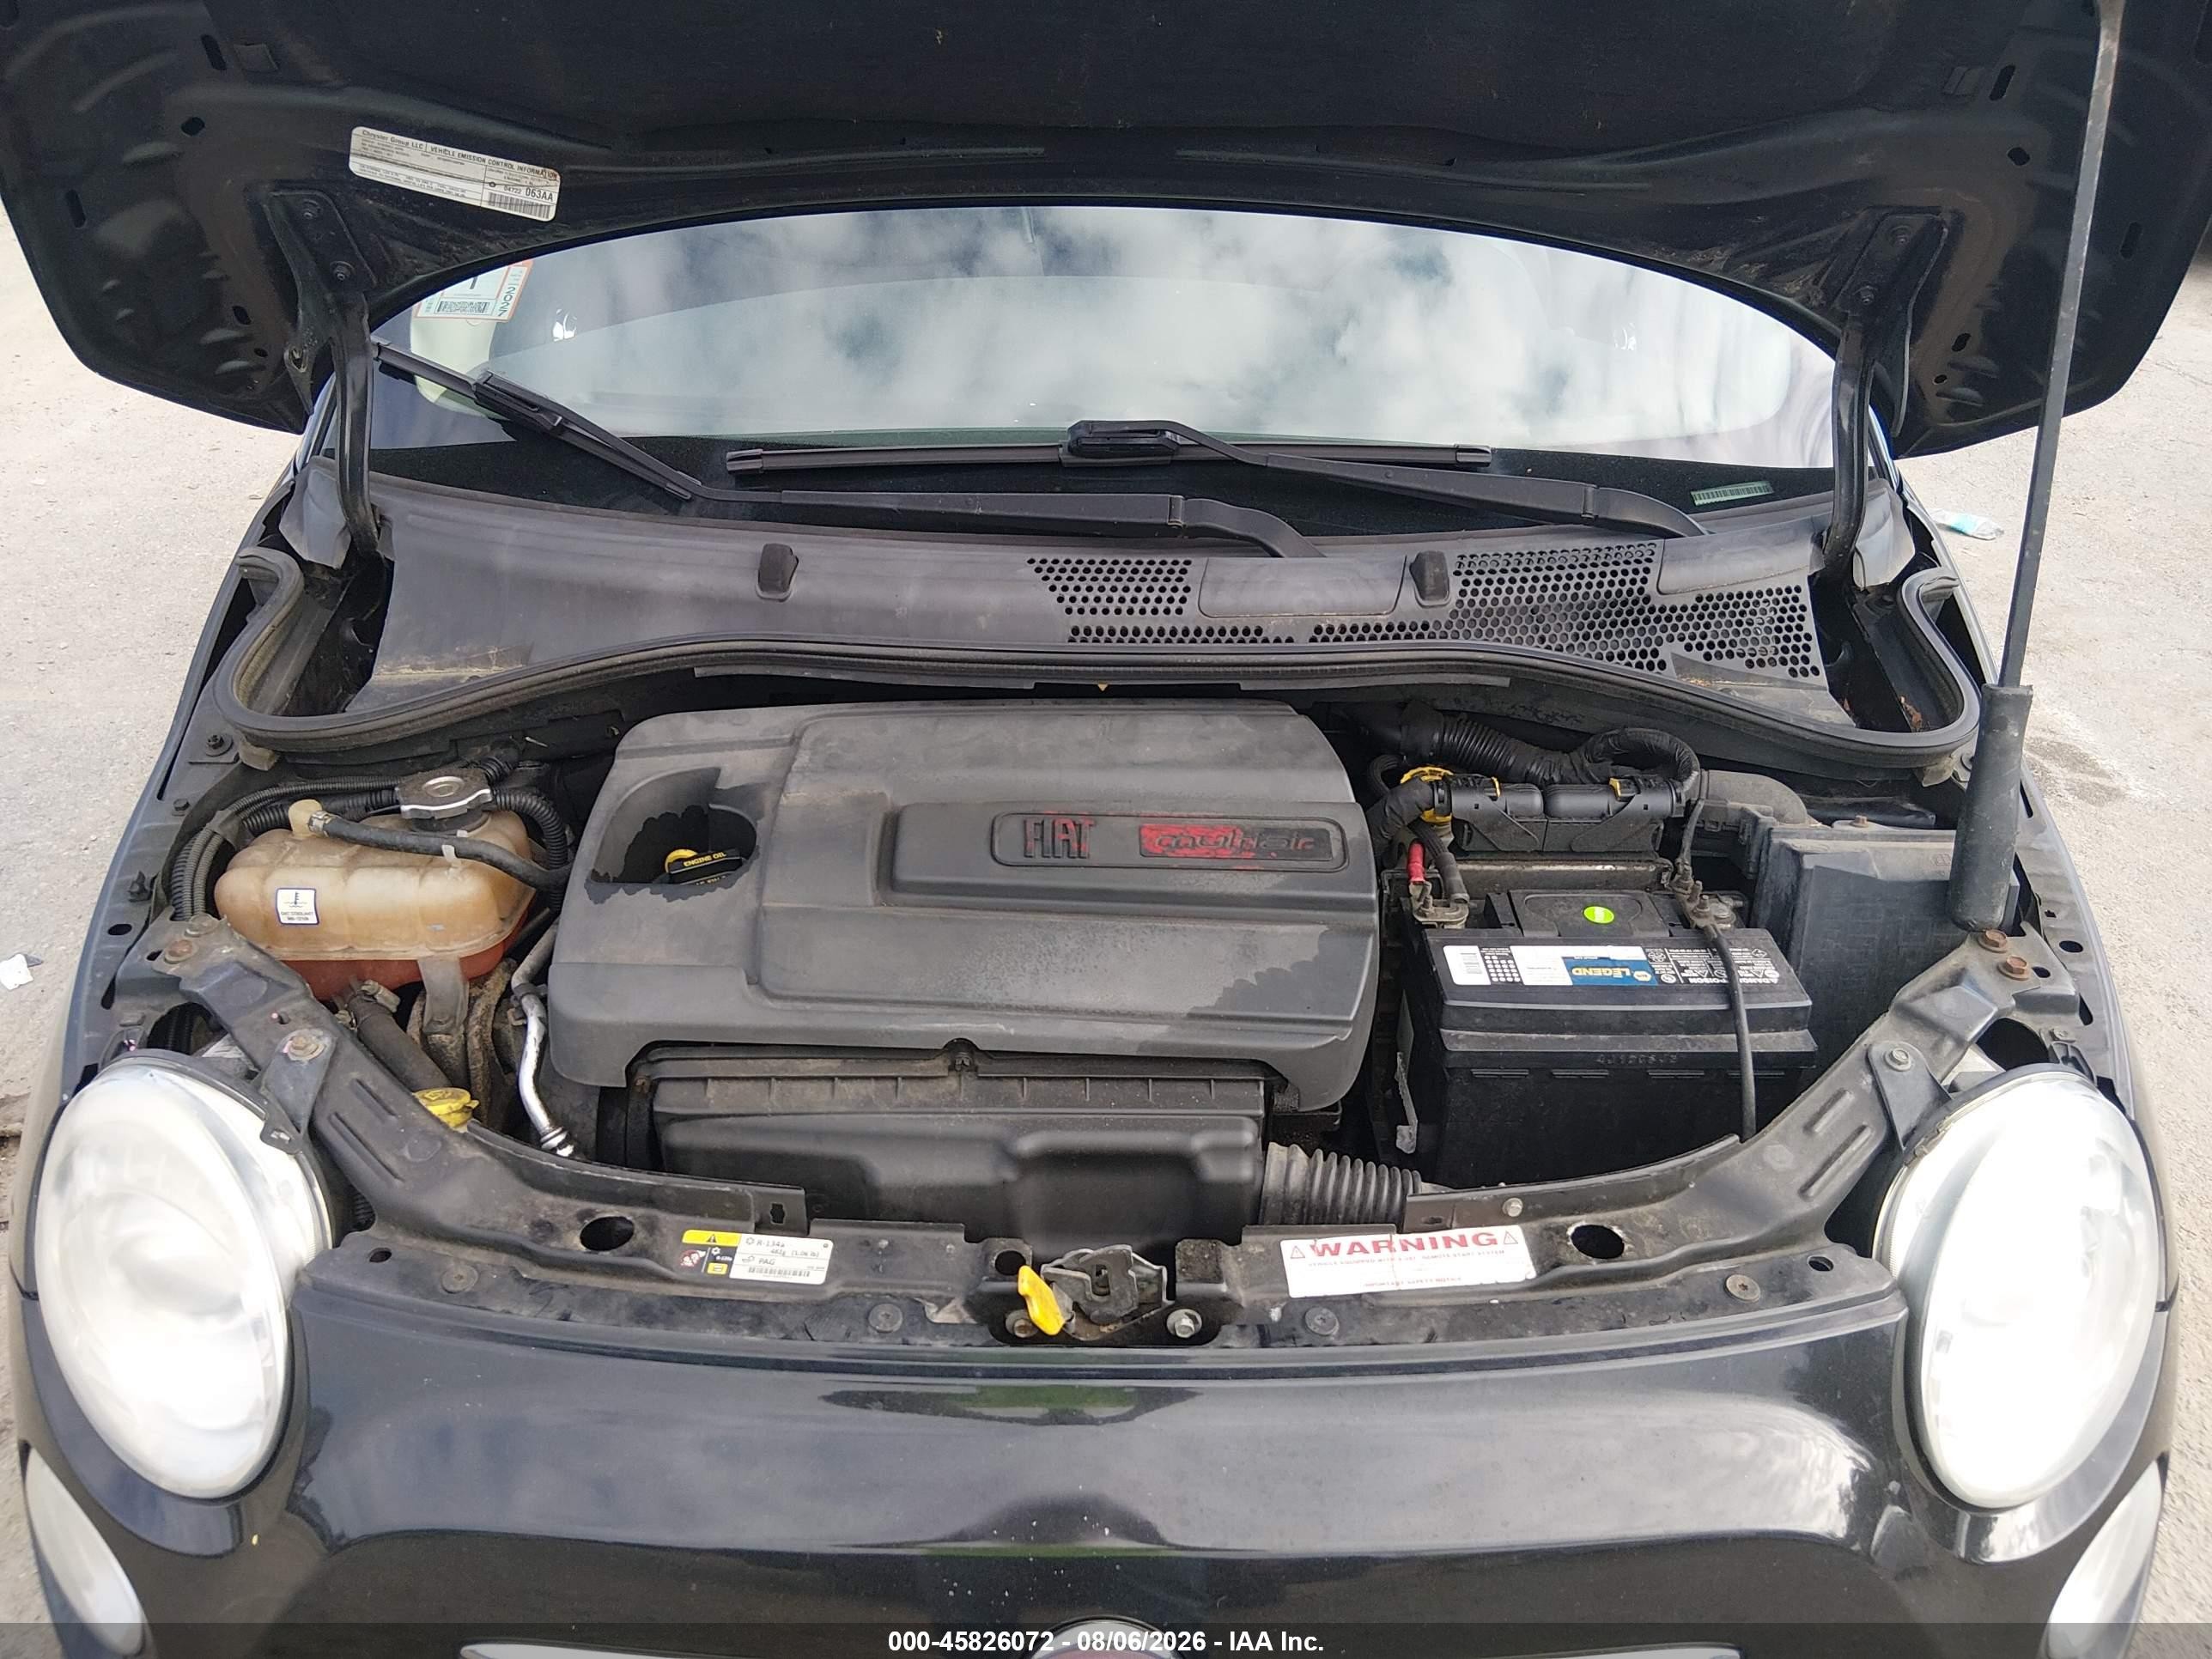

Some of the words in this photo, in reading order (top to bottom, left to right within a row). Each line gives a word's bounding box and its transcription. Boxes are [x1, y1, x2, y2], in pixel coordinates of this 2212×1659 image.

[362, 130, 389, 142] Chrysler
[390, 137, 410, 147] Group
[431, 147, 455, 157] VEHICLE
[457, 152, 486, 163] EMISSION
[488, 159, 515, 169] CONTROL
[517, 165, 558, 179] INFORMATION
[525, 187, 554, 202] 063AA
[1024, 817, 1095, 859] FIAT
[683, 854, 712, 867] ENGINE
[712, 851, 727, 861] OIL
[1571, 967, 1632, 978] LEGEND
[1310, 1232, 1498, 1257] WARNING
[758, 1257, 777, 1266] PAG
